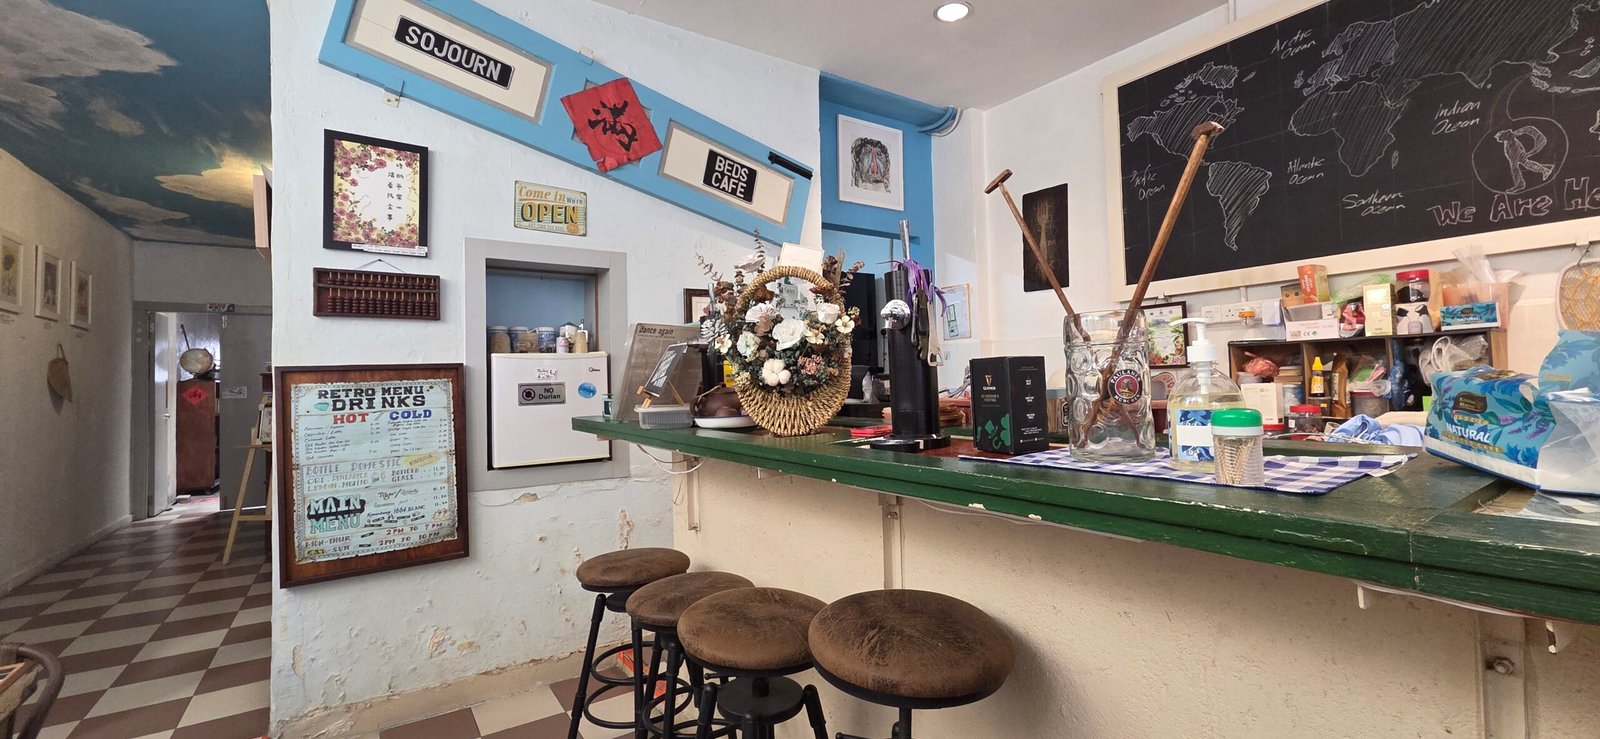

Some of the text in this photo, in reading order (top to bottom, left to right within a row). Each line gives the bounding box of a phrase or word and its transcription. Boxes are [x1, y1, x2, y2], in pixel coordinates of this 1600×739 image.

[405, 25, 502, 81] SOJOURN
[1434, 100, 1481, 120] Indian
[1432, 117, 1480, 135] Ocean
[715, 155, 749, 182] BEDS
[518, 184, 566, 202] Come in
[711, 172, 747, 198] CAFE
[521, 202, 579, 225] OPEN
[1427, 201, 1476, 226] We
[1490, 193, 1552, 222] Are
[639, 325, 674, 336] dance again
[317, 385, 424, 399] RETRO MENU
[331, 395, 426, 412] DRINKS
[333, 412, 369, 425] HOT
[389, 409, 432, 421] COLD
[1446, 423, 1491, 443] NATURAL
[306, 458, 401, 476] BOTTLE DOMESTIC
[332, 472, 368, 482] PINEAPPLE
[391, 474, 415, 482] GLASS
[309, 494, 362, 516] MAIN
[408, 503, 426, 512] BLANC
[310, 512, 361, 534] MENU
[333, 544, 350, 552] SUN
